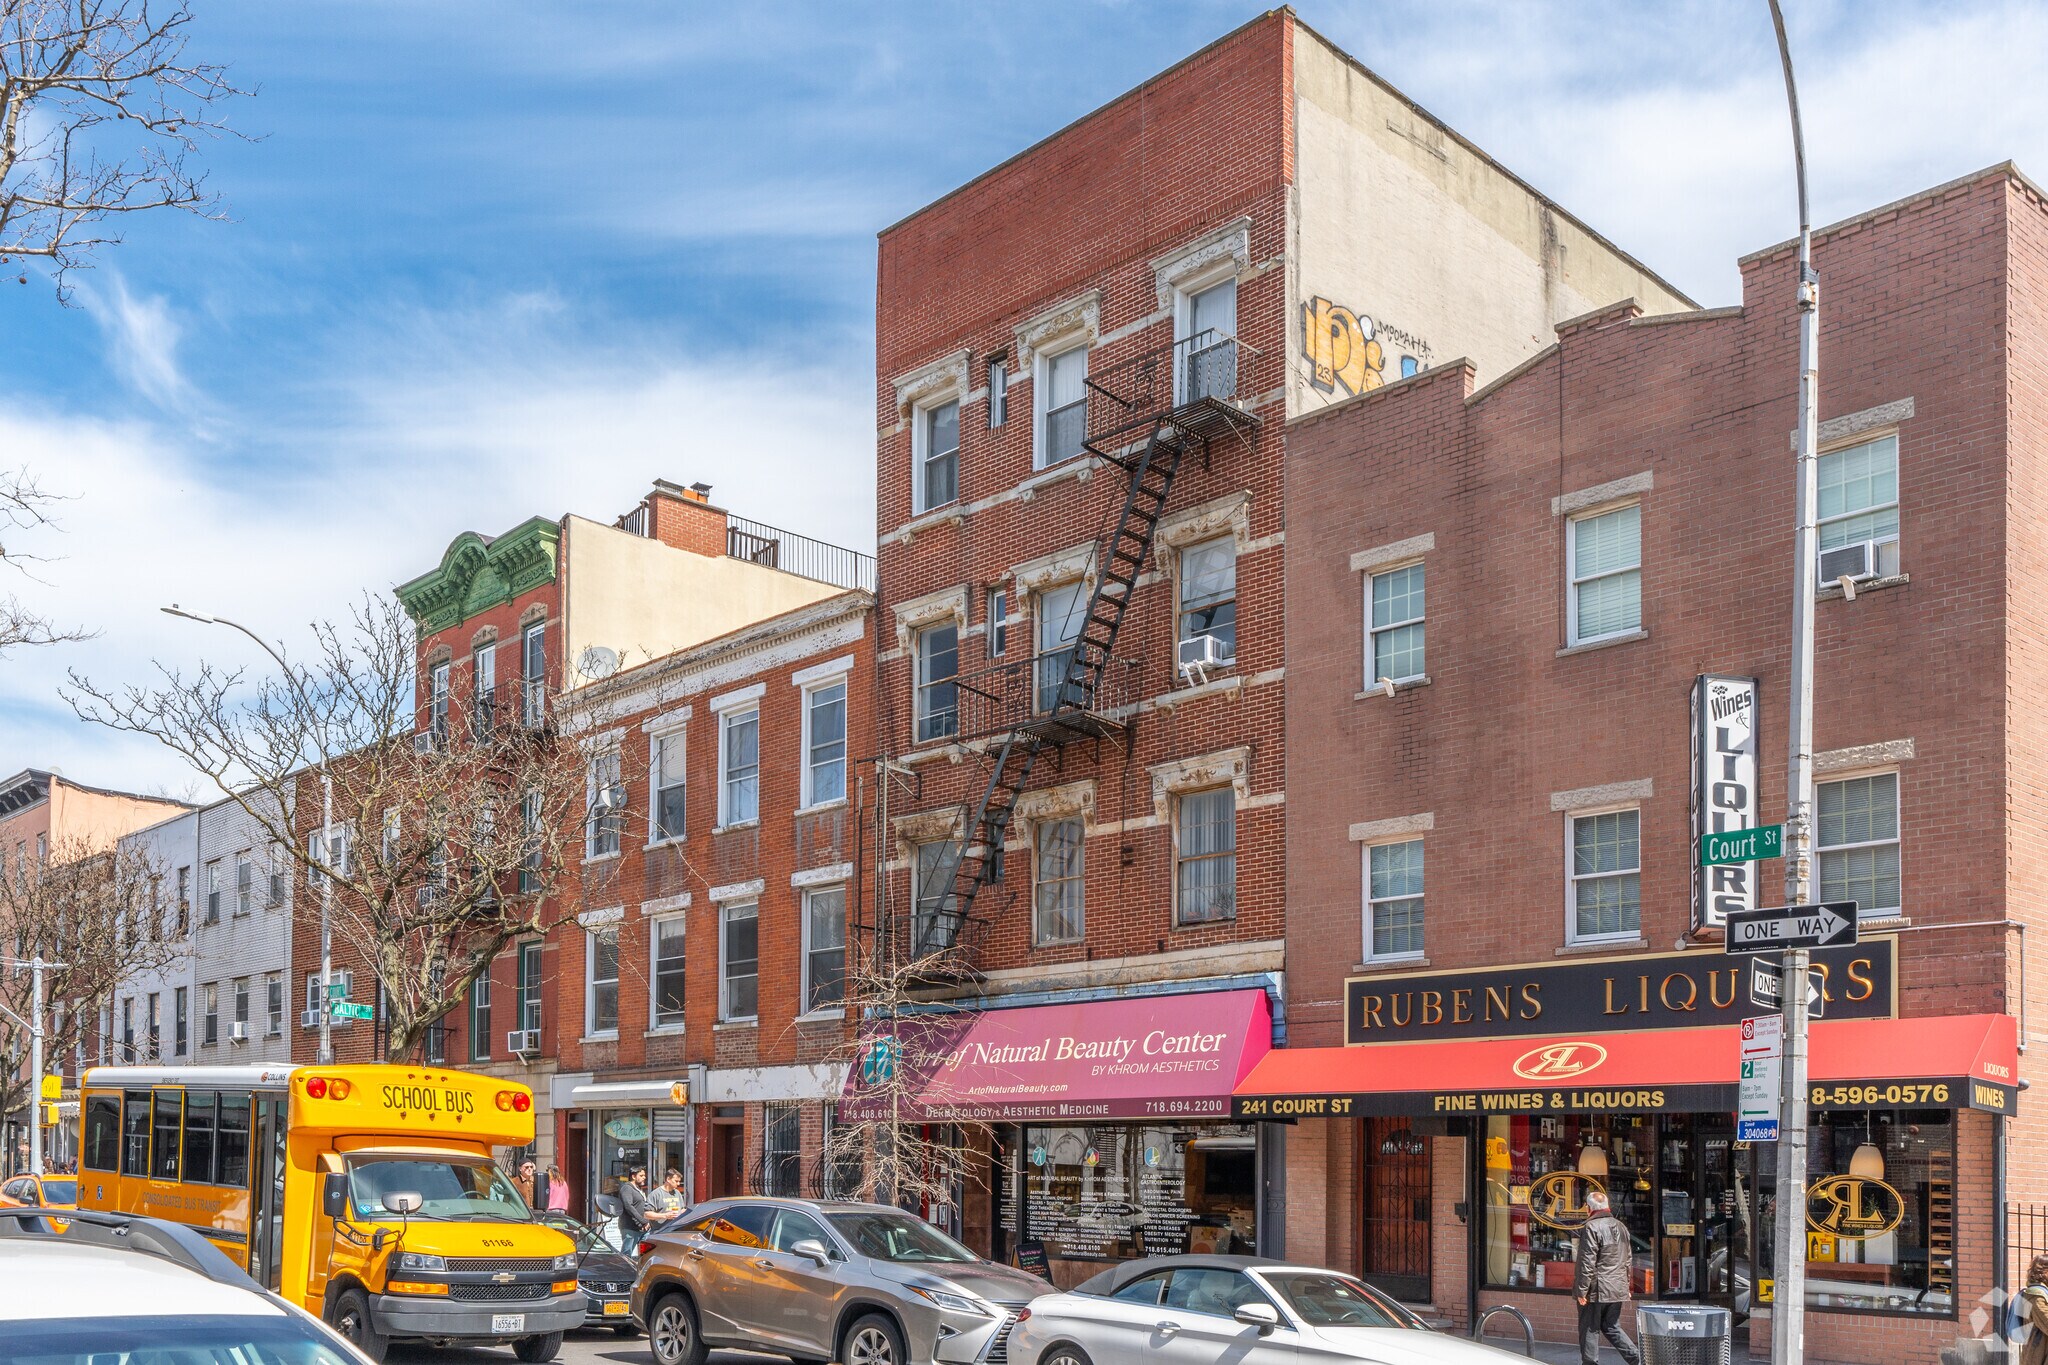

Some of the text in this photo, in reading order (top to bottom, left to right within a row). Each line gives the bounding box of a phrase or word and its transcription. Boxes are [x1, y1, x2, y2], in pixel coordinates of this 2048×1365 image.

[1710, 689, 1752, 721] Wines
[1711, 726, 1748, 921] LIQURS
[1709, 830, 1777, 861] Court St
[1744, 916, 1836, 940] ONE WAY
[1758, 974, 1777, 994] ONE
[1361, 958, 1873, 1029] RUBENS LIQURS
[334, 1004, 359, 1017] BALTIC
[945, 1042, 974, 1072] of
[971, 1038, 1051, 1065] Natural
[1054, 1036, 1137, 1063] Beauty
[1142, 1030, 1227, 1055] Center
[1091, 1059, 1220, 1076] BY KHROM AESTHETICS
[1743, 1061, 1751, 1077] 2
[1983, 1062, 2010, 1078] LIQUORS
[267, 1073, 287, 1082] COLLINS
[968, 1084, 1069, 1095] ArtofNaturalBeauty.com
[1741, 1091, 1769, 1100] Except Sunday
[1811, 1084, 1949, 1105] 8-596-0576
[1975, 1085, 2005, 1108] WINES
[382, 1085, 474, 1114] SCHOOL BUS
[1145, 1099, 1223, 1113] 718.694.2200
[1241, 1098, 1353, 1115] 241 COURT ST
[1434, 1090, 1665, 1111] FINE WINES & LIQUORS
[1003, 1105, 1056, 1117] AESTHETIC
[1060, 1103, 1109, 1115] MEDICINE
[1744, 1127, 1768, 1139] 304068
[143, 1191, 221, 1213] CONSOLIDATED BUS TRANSIT
[1668, 1320, 1695, 1331] NYC
